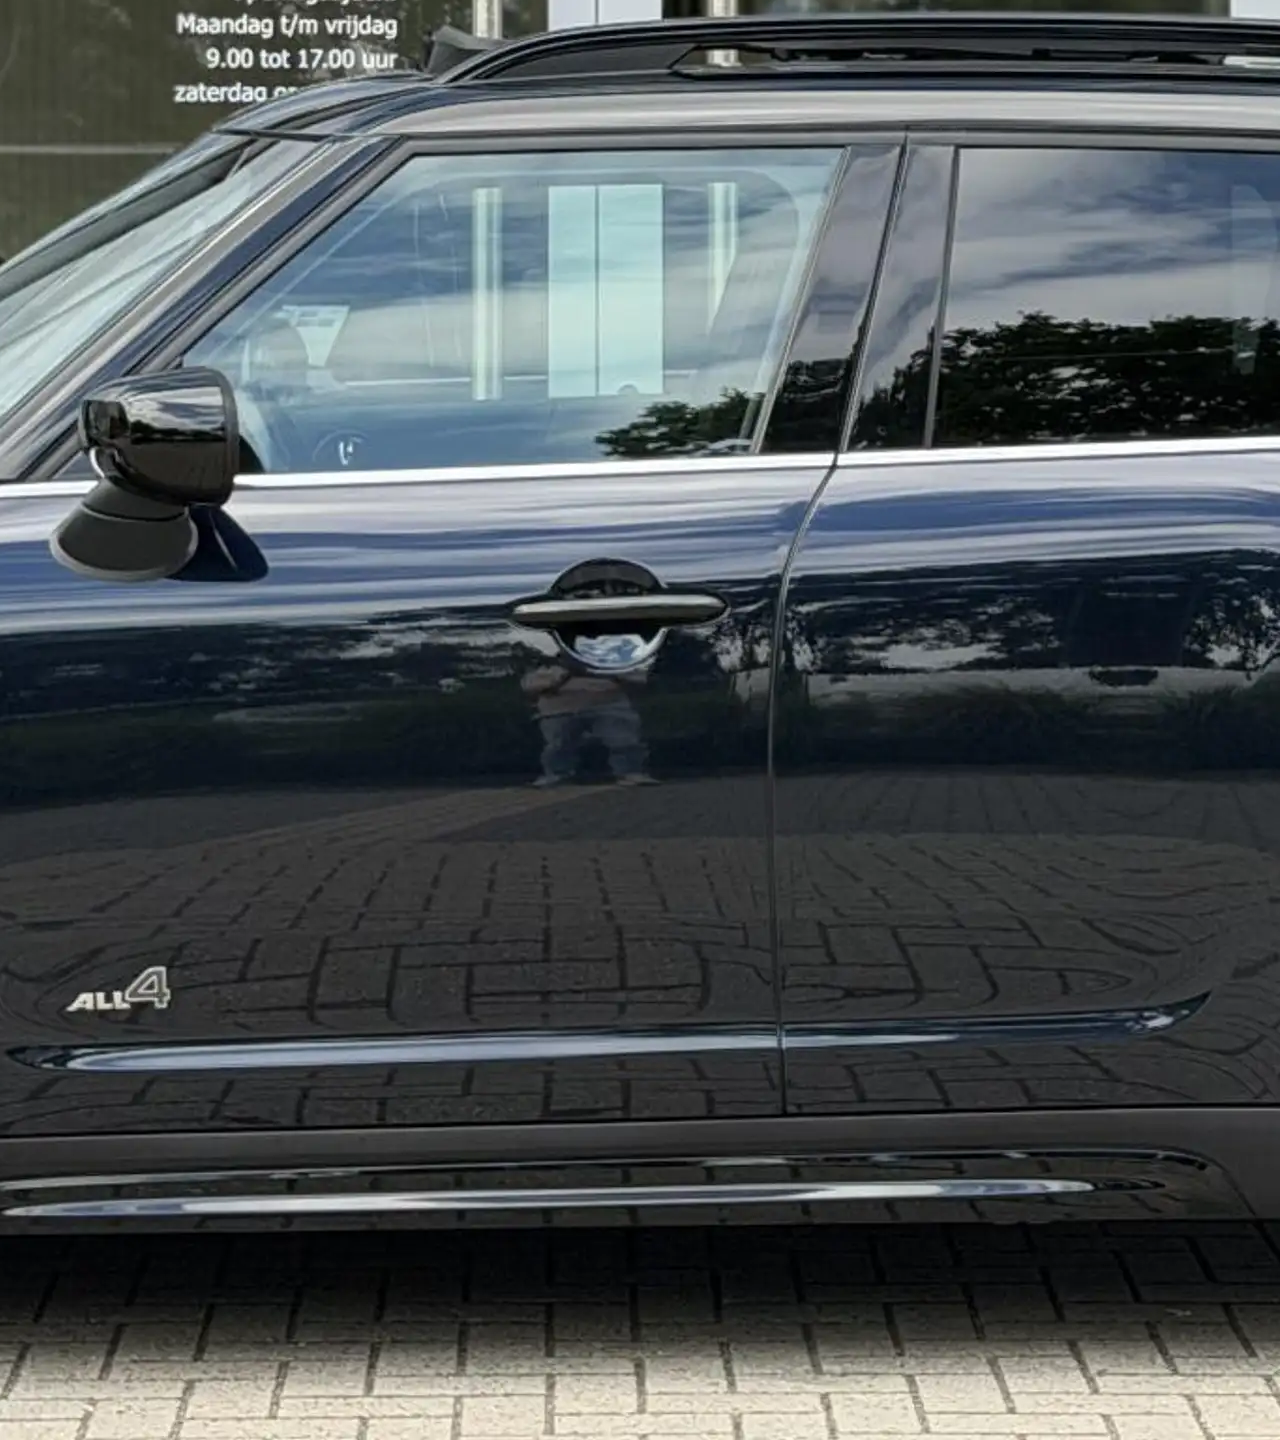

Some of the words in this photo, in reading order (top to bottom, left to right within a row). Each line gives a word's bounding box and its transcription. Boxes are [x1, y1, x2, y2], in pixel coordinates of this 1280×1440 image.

[176, 13, 274, 39] Maandag
[279, 14, 318, 36] t/m
[324, 14, 398, 39] vrijdag
[206, 48, 254, 69] 9.00
[259, 49, 291, 69] tot
[298, 48, 355, 69] 17.00
[361, 52, 399, 69] uur
[173, 81, 268, 102] zaterdag
[65, 965, 171, 1012] ALL4
